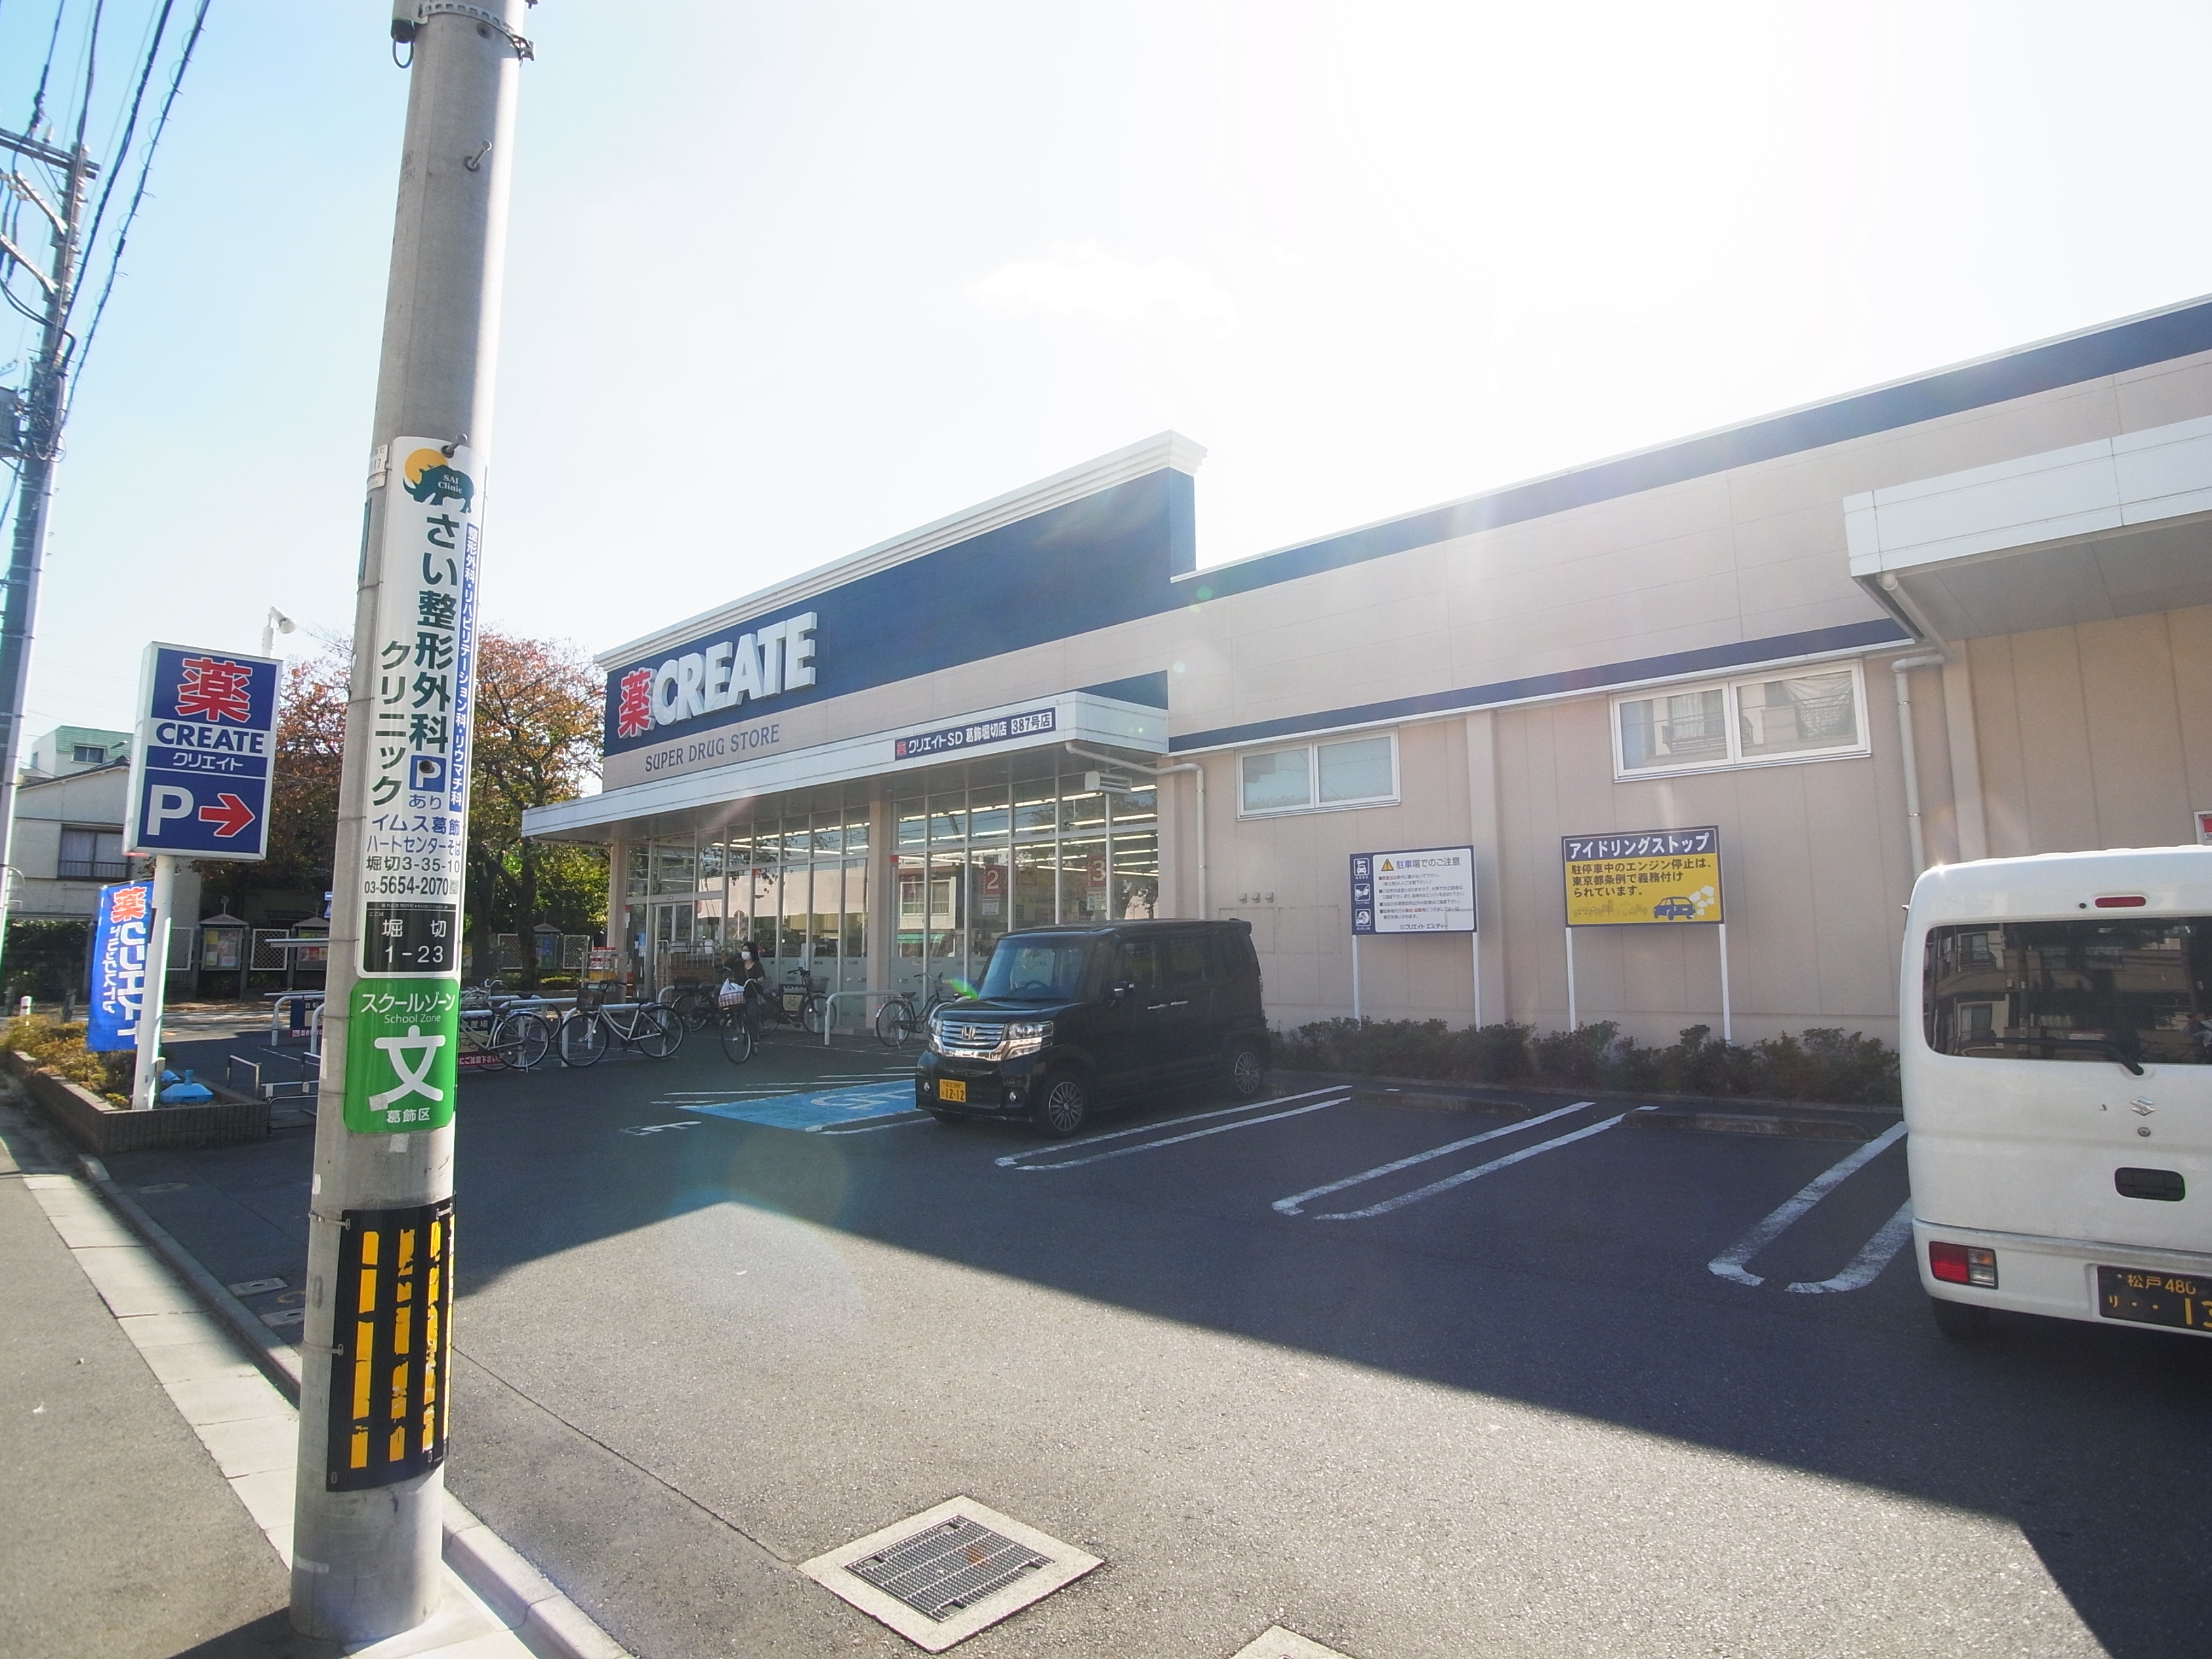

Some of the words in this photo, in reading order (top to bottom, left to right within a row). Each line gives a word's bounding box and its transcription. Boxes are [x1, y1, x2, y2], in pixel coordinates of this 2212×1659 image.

[438, 480, 464, 493] Clinic
[443, 474, 459, 485] SAI
[409, 513, 461, 754] さい整形外科
[617, 667, 657, 739] 薬
[652, 611, 817, 726] CREATE
[174, 657, 253, 724] 薬
[371, 640, 411, 806] クリニック
[908, 731, 964, 754] クリエイトSD
[1012, 713, 1051, 734] 387号店
[156, 722, 265, 754] CREATE
[645, 748, 684, 773] SUPER
[689, 738, 725, 762] DRUG
[730, 724, 780, 753] STORE
[173, 752, 243, 771] クリエイト
[416, 760, 441, 788] P
[146, 784, 194, 836] P
[408, 794, 443, 811] あり
[372, 814, 461, 838] イムス葛飾
[367, 835, 461, 857] ハートセンターそば
[1569, 832, 1710, 860] アイドリングストップ
[366, 856, 461, 874] 堀切3-35-10
[1093, 859, 1107, 882] 3
[1396, 857, 1460, 869] 駐車場でのご注意
[1571, 857, 1711, 876] 駐停車中のエンジン停止は、
[364, 876, 449, 897] 03-5654-2070
[987, 869, 999, 890] 2
[1572, 872, 1683, 886] 東京都条例で義務付け
[1573, 886, 1643, 898] られています。
[361, 991, 455, 1014] スクールゾーン
[384, 1014, 418, 1024] School
[419, 1013, 441, 1023] Zone
[369, 1025, 447, 1111] 文
[386, 1107, 431, 1124] 葛飾区
[2127, 1273, 2162, 1289] 松戸
